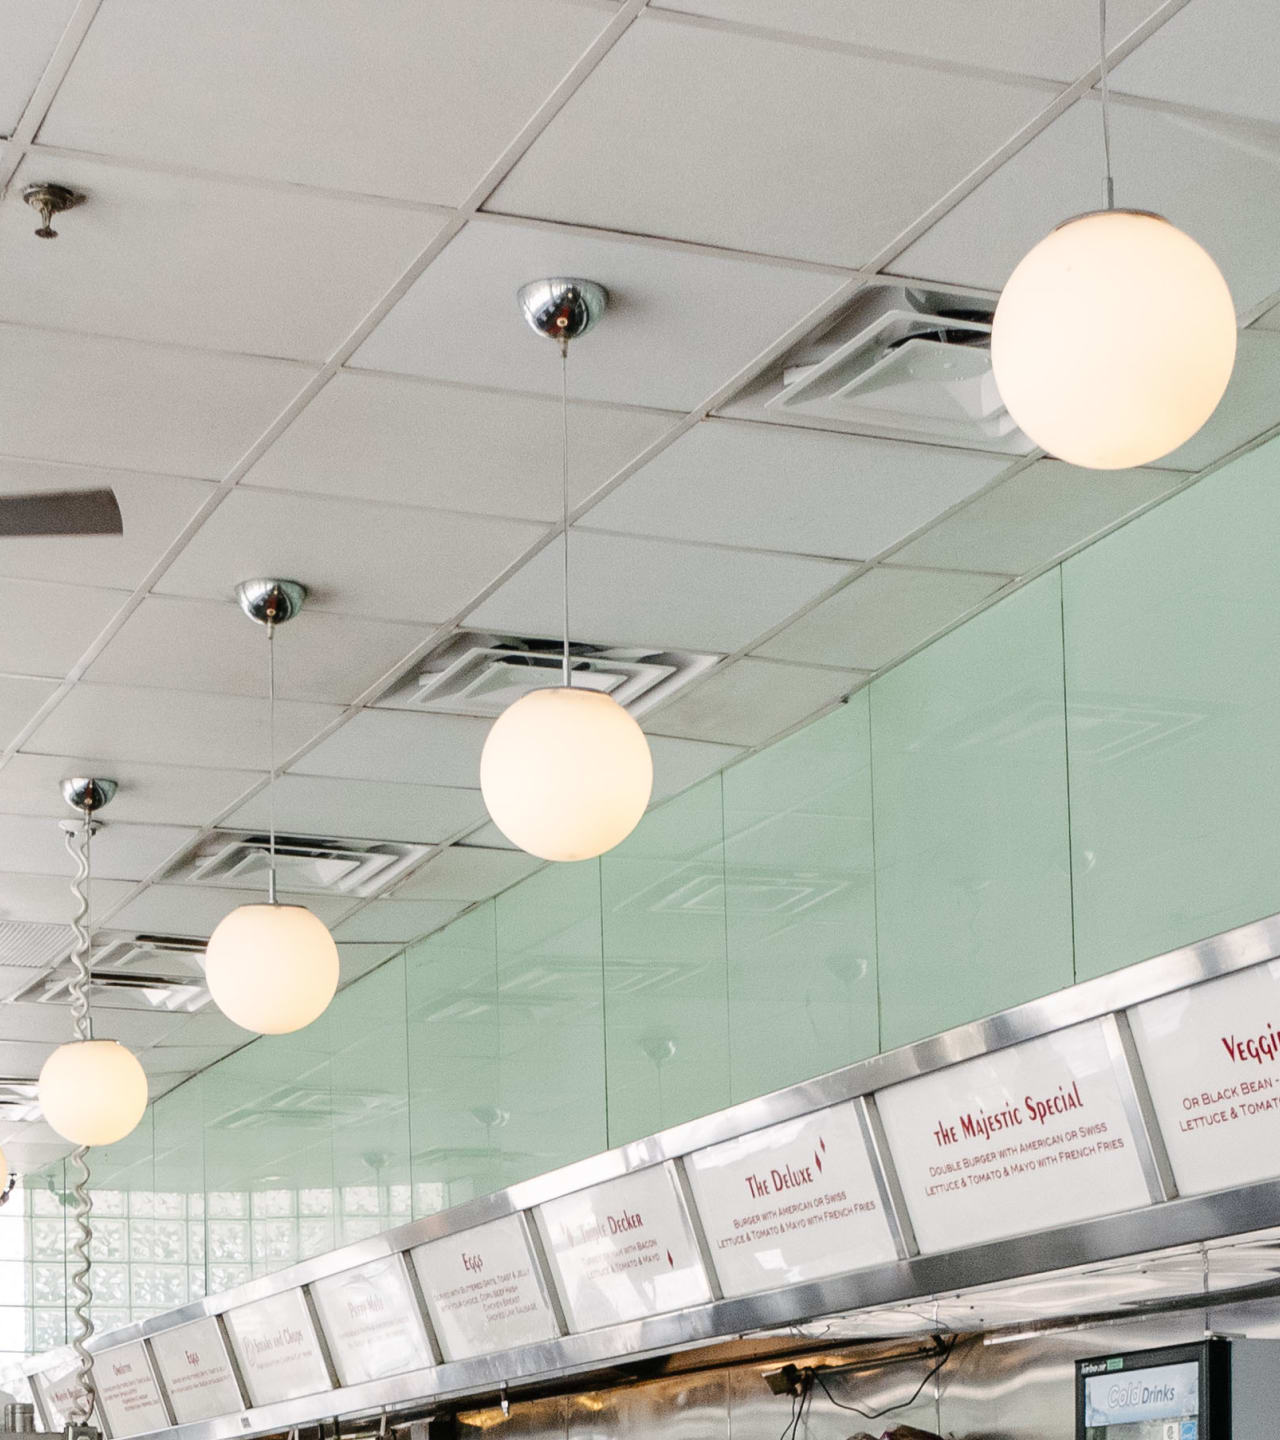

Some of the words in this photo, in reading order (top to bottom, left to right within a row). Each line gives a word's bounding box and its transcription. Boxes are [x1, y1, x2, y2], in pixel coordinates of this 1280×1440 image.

[1230, 1107, 1238, 1120] &
[745, 1173, 770, 1199] The
[960, 1177, 967, 1188] &
[1003, 1166, 1010, 1177] &
[461, 1252, 483, 1274] Eggs
[1107, 1381, 1142, 1409] Cold
[1142, 1384, 1176, 1404] Drinks
